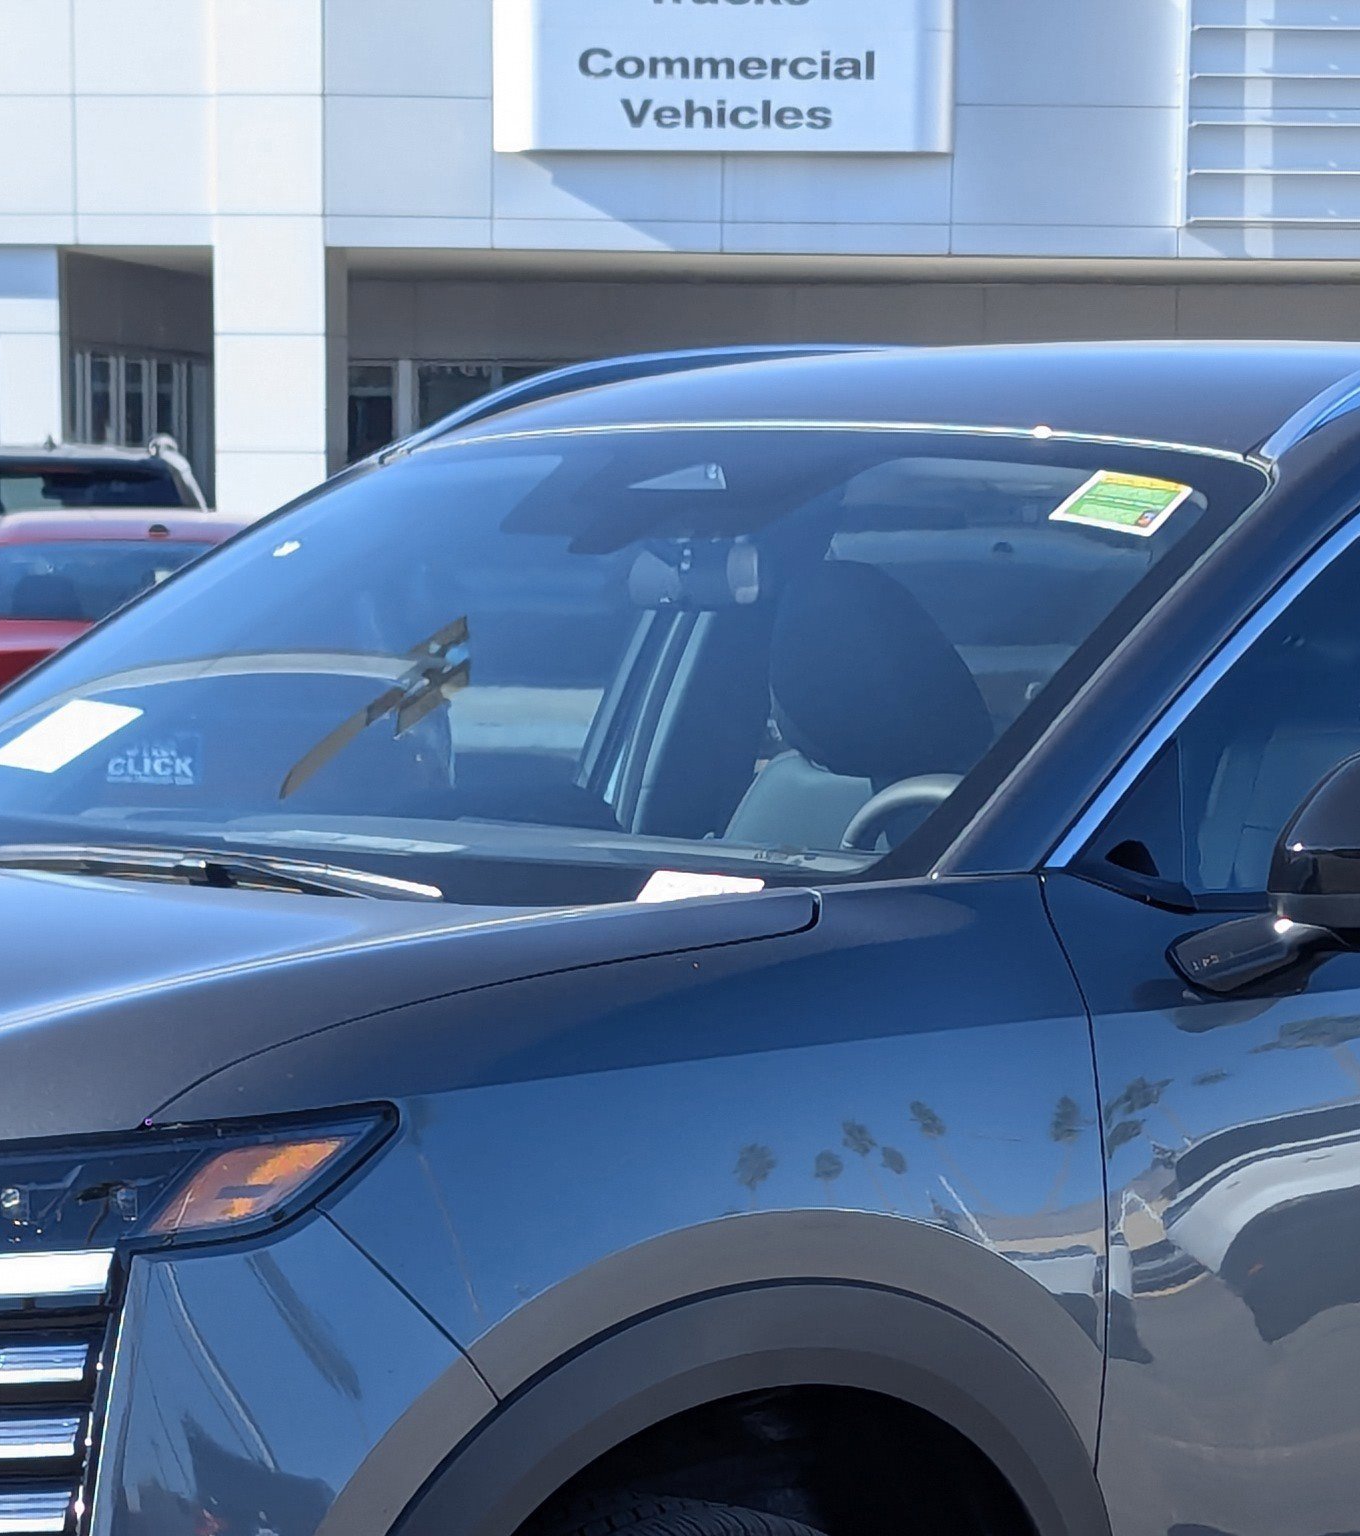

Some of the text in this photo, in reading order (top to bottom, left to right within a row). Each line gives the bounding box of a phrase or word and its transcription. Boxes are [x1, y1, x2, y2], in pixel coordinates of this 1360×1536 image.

[578, 48, 875, 80] Commercial
[619, 98, 833, 130] Vehicles
[107, 757, 193, 777] CLICK
